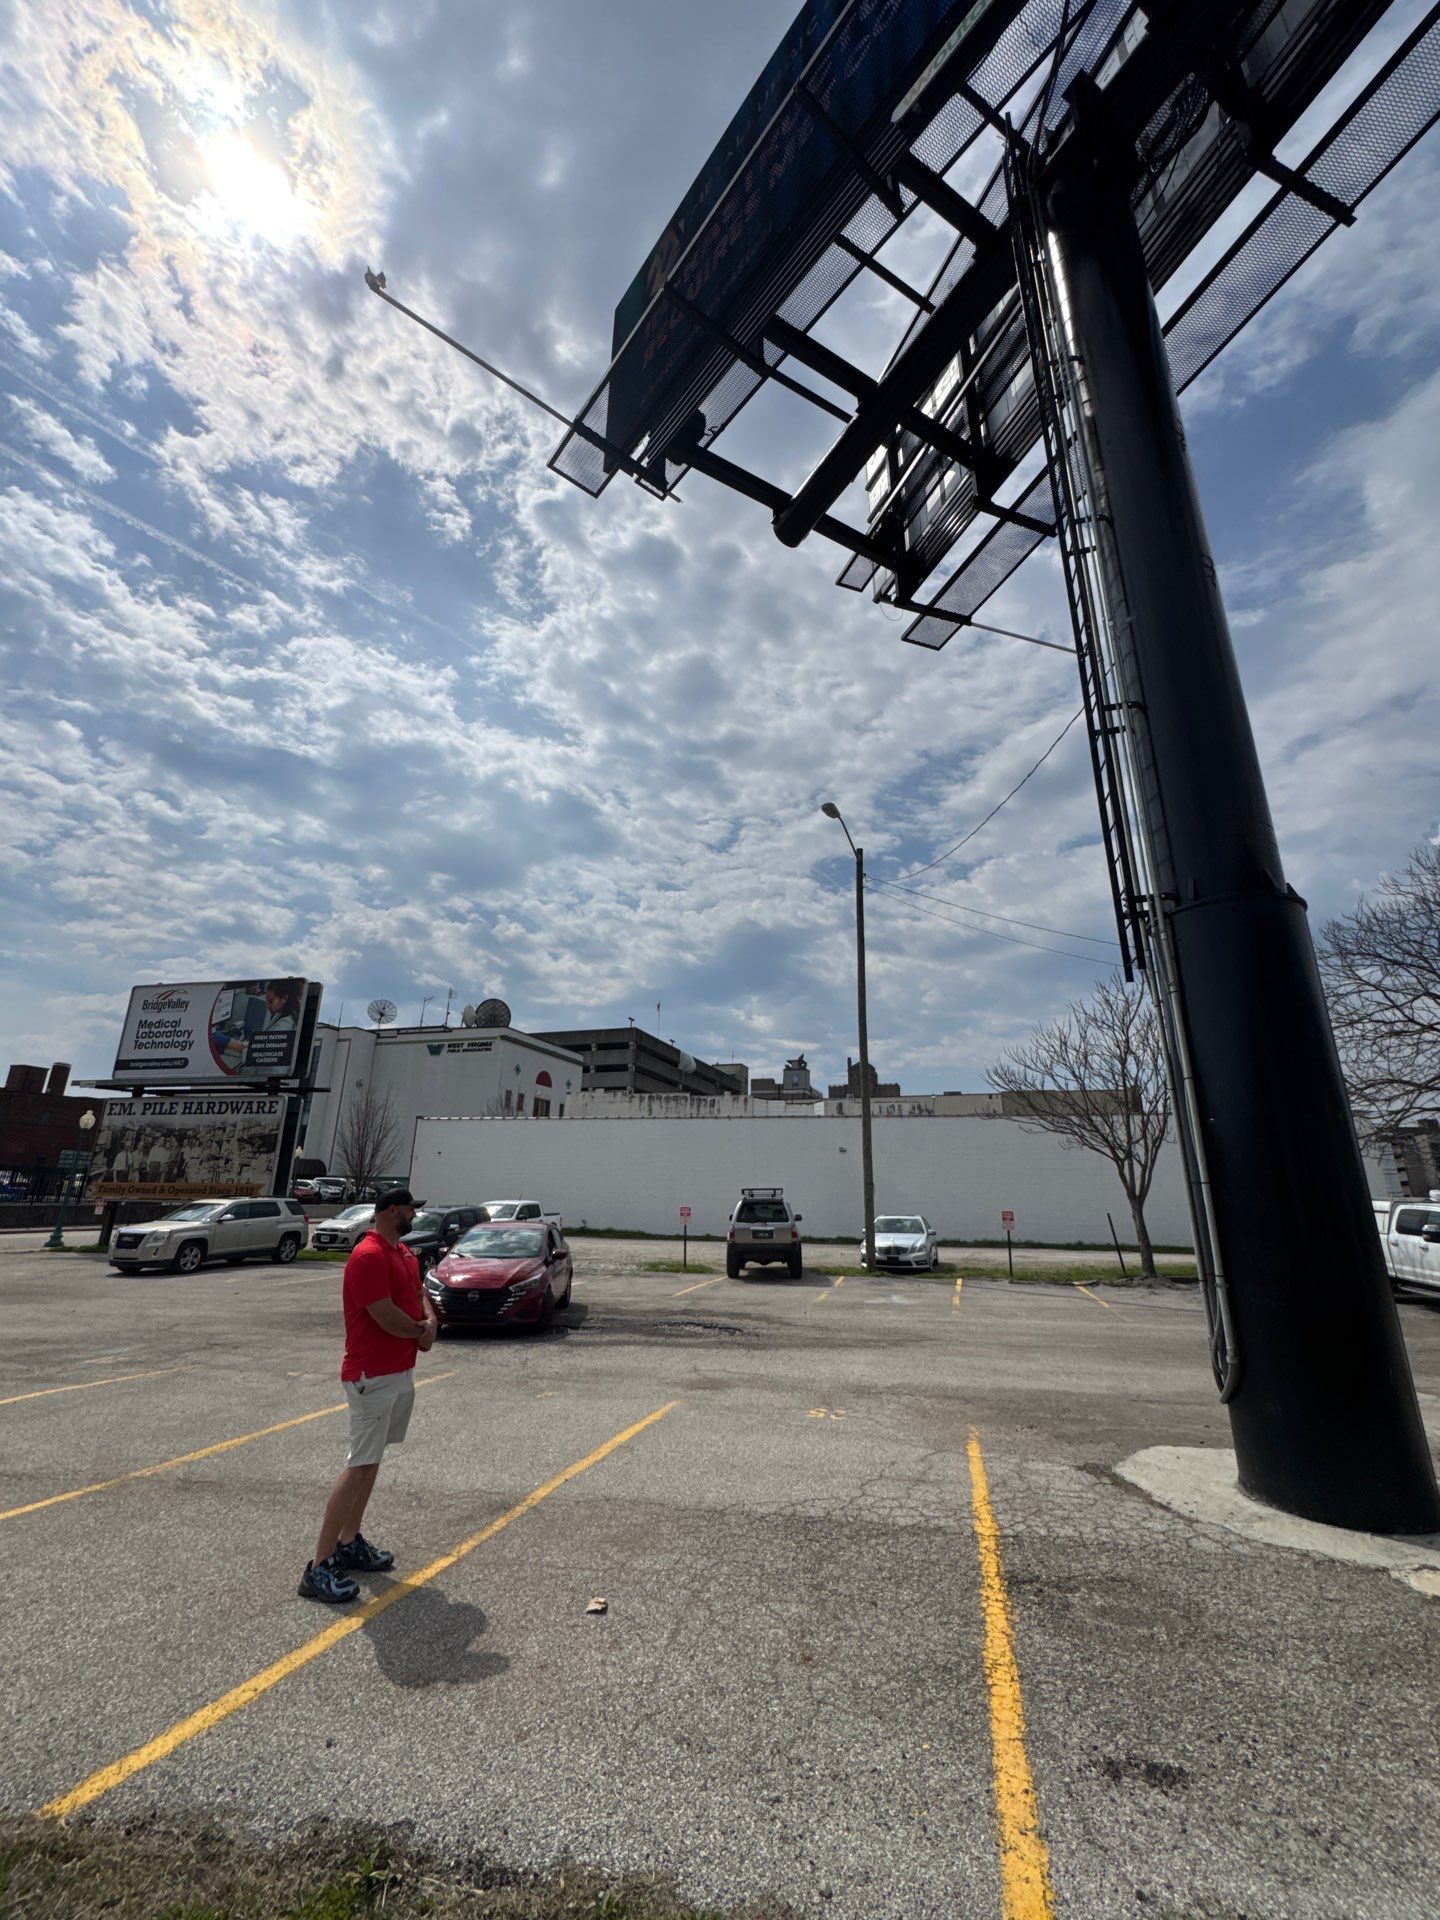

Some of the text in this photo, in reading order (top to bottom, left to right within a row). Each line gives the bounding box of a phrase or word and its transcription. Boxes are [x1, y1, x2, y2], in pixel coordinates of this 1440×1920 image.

[142, 998, 190, 1013] BridgeValley
[138, 1018, 181, 1029] Medical
[136, 1029, 193, 1040] Laboratory
[134, 1039, 194, 1051] Technology
[107, 1100, 279, 1116] F.M. PILE HARDWARE
[98, 1184, 255, 1197] Family Owned & Operated Since 1932
